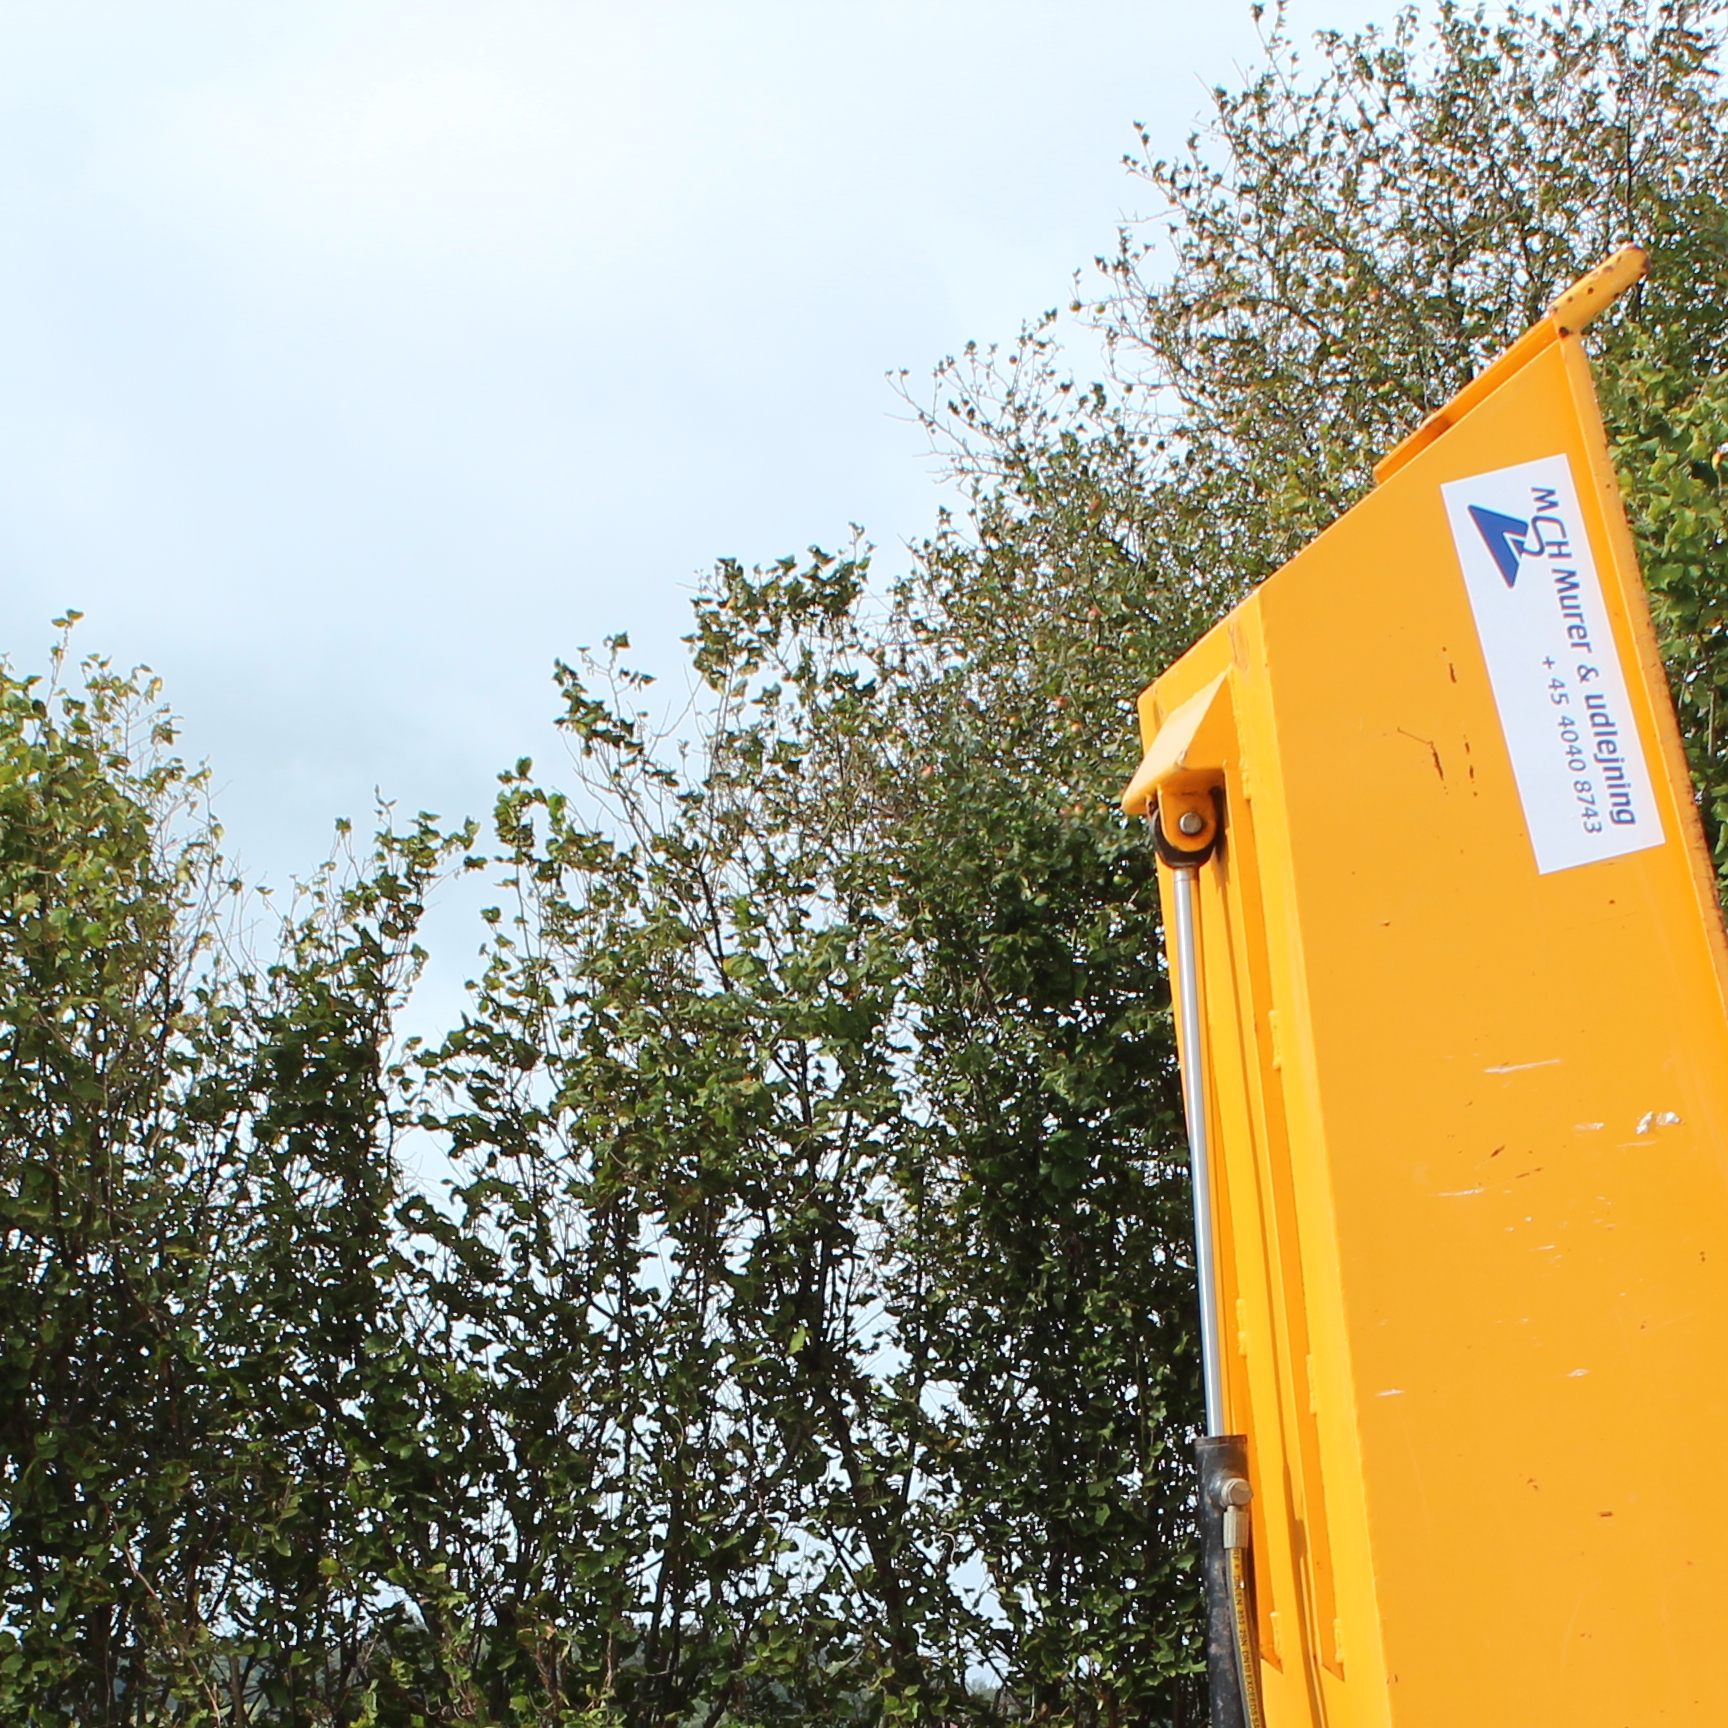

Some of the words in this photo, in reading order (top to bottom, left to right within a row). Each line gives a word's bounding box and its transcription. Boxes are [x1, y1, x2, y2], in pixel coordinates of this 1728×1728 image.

[1531, 487, 1571, 559] MCH
[1551, 568, 1592, 653] Murer
[1548, 678, 1570, 705] 45
[1577, 664, 1600, 684] &
[1558, 715, 1586, 772] 4040
[1585, 693, 1637, 825] udlejning
[1573, 780, 1602, 834] 8743
